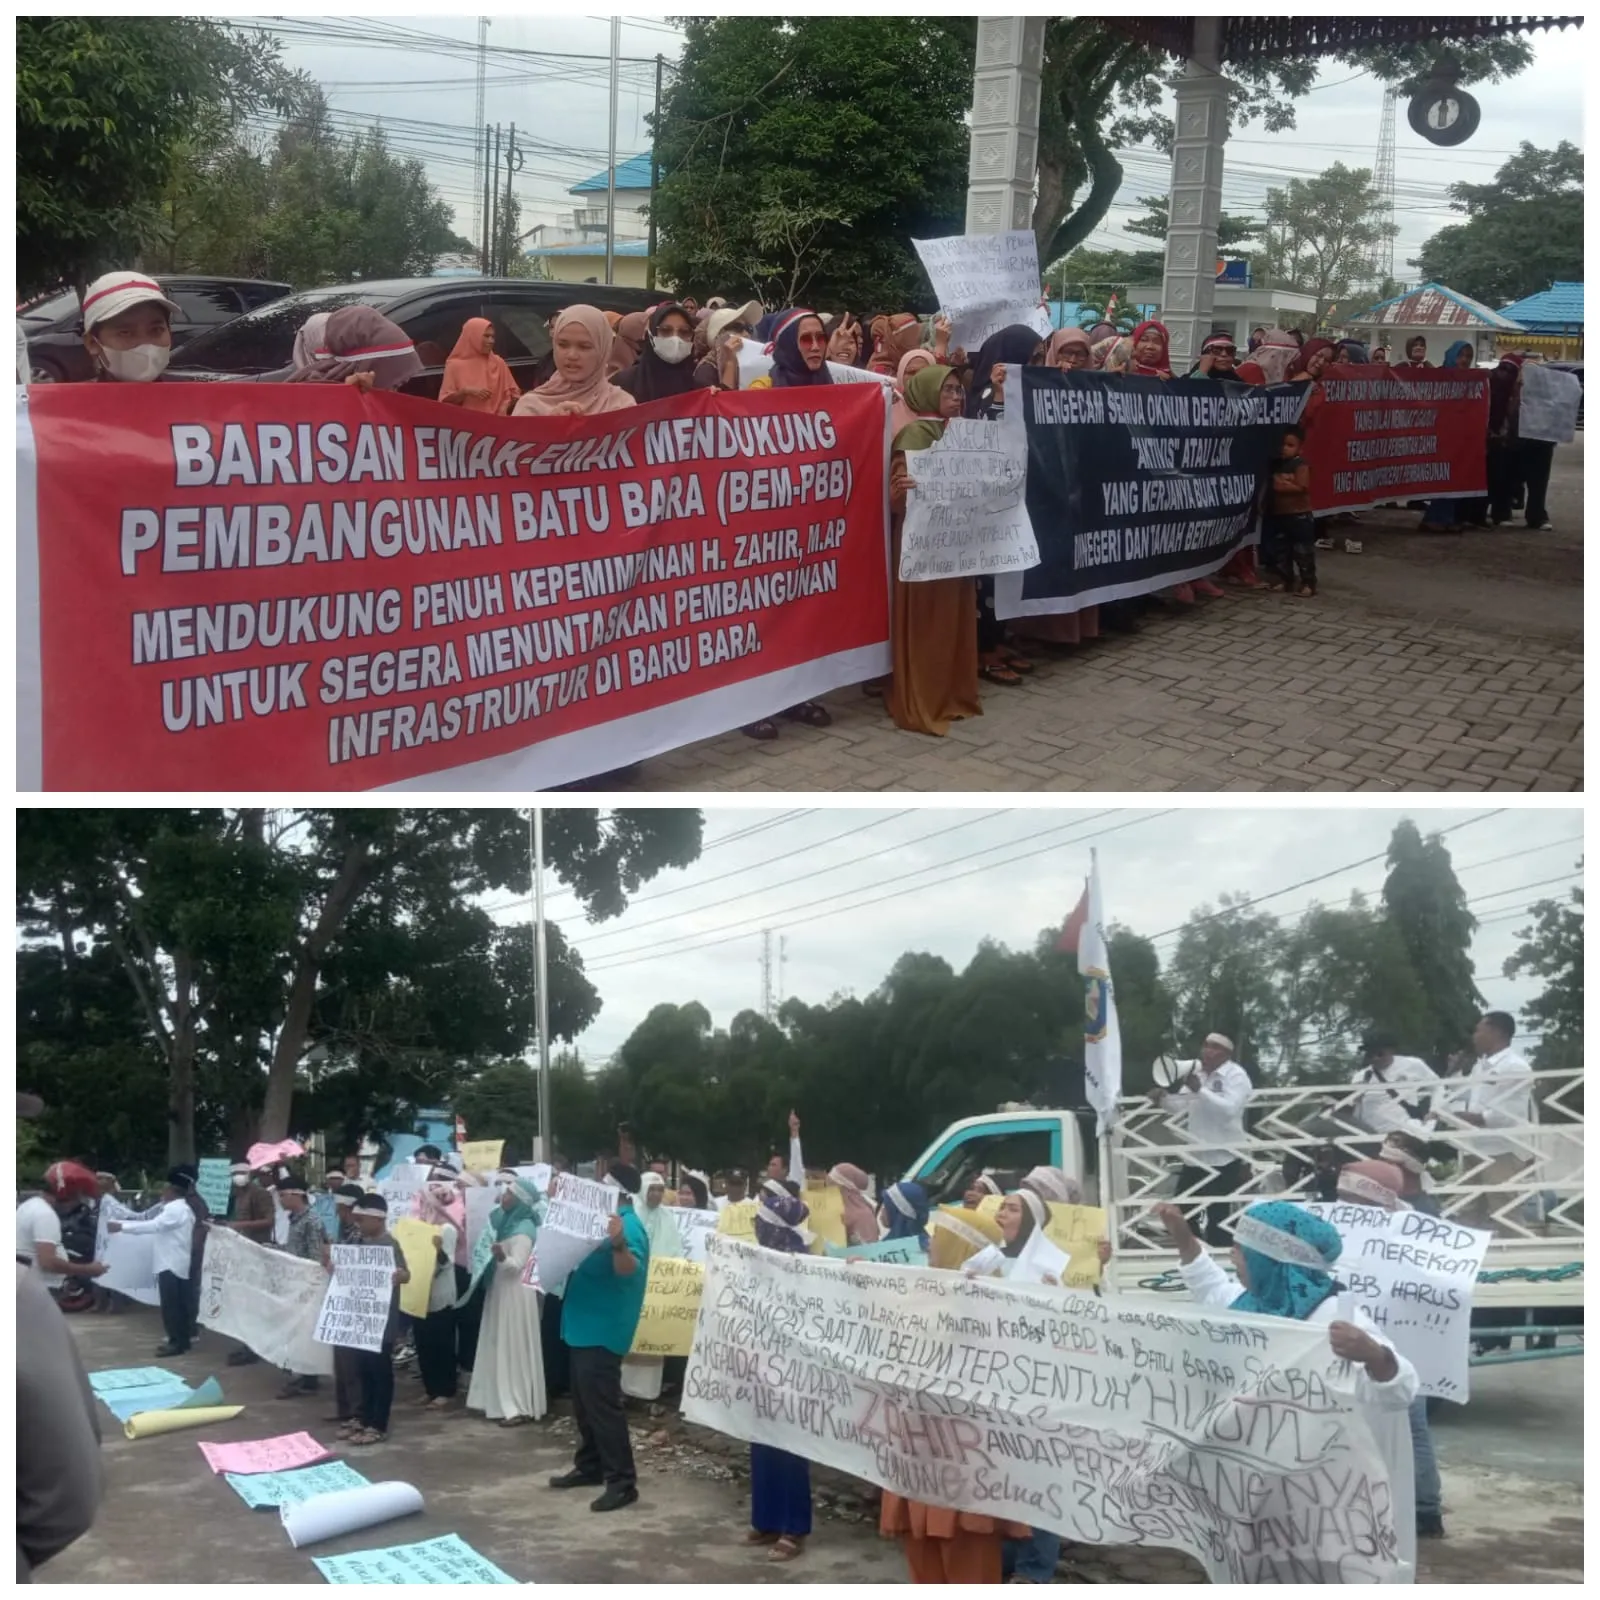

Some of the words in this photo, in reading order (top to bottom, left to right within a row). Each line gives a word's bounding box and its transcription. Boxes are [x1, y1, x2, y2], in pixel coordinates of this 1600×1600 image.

[1032, 388, 1105, 426] MENGECAM
[1107, 391, 1146, 425] SEMUA
[1147, 394, 1189, 427] OKNUM
[171, 423, 405, 487] BARISAN
[413, 425, 638, 482] EMAK-EMAK
[644, 410, 837, 467] MENDUKUNG
[120, 494, 503, 577] PEMBANGUNAN
[512, 484, 610, 543] BATU
[619, 473, 706, 528] BARA
[716, 459, 853, 526] (BEM-PBB)
[1102, 480, 1139, 516] YANG
[1141, 477, 1195, 513] KERJANYA
[1219, 474, 1255, 506] GADUH
[1125, 524, 1150, 560] DAN
[131, 588, 401, 665] MENDUKUNG
[412, 574, 505, 631] PENUH
[510, 540, 696, 612] KEPEMIMPINAN
[701, 538, 727, 574] H.
[734, 528, 804, 569] ZAHIR,
[807, 518, 846, 556] M.AP
[162, 662, 310, 733] UNTUK
[319, 641, 463, 705] SEGERA
[465, 592, 669, 680] MENUNTASKAN
[674, 559, 837, 627] PEMBANGUNAN
[328, 664, 588, 765] INFRASTRUKTUR
[594, 653, 620, 697] DI
[628, 634, 691, 687] BARU
[698, 621, 761, 669] BARA.
[1331, 1206, 1392, 1228] KEPADA
[1401, 1215, 1475, 1250] DPRD
[1361, 1239, 1479, 1278] MEREKOM
[914, 1277, 946, 1297] ATAS
[1201, 1318, 1269, 1350] BARA
[1391, 1280, 1461, 1311] HARUS
[804, 1316, 858, 1349] SAAT
[885, 1334, 954, 1376] BELUM
[936, 1310, 991, 1338] MANTAN
[1048, 1318, 1097, 1350] BPBD
[1131, 1336, 1175, 1374] BATU
[1182, 1348, 1236, 1387] BARA
[704, 1334, 762, 1385] KEPADA
[763, 1354, 852, 1406] SAUDARA
[852, 1383, 998, 1469] ZAHIR
